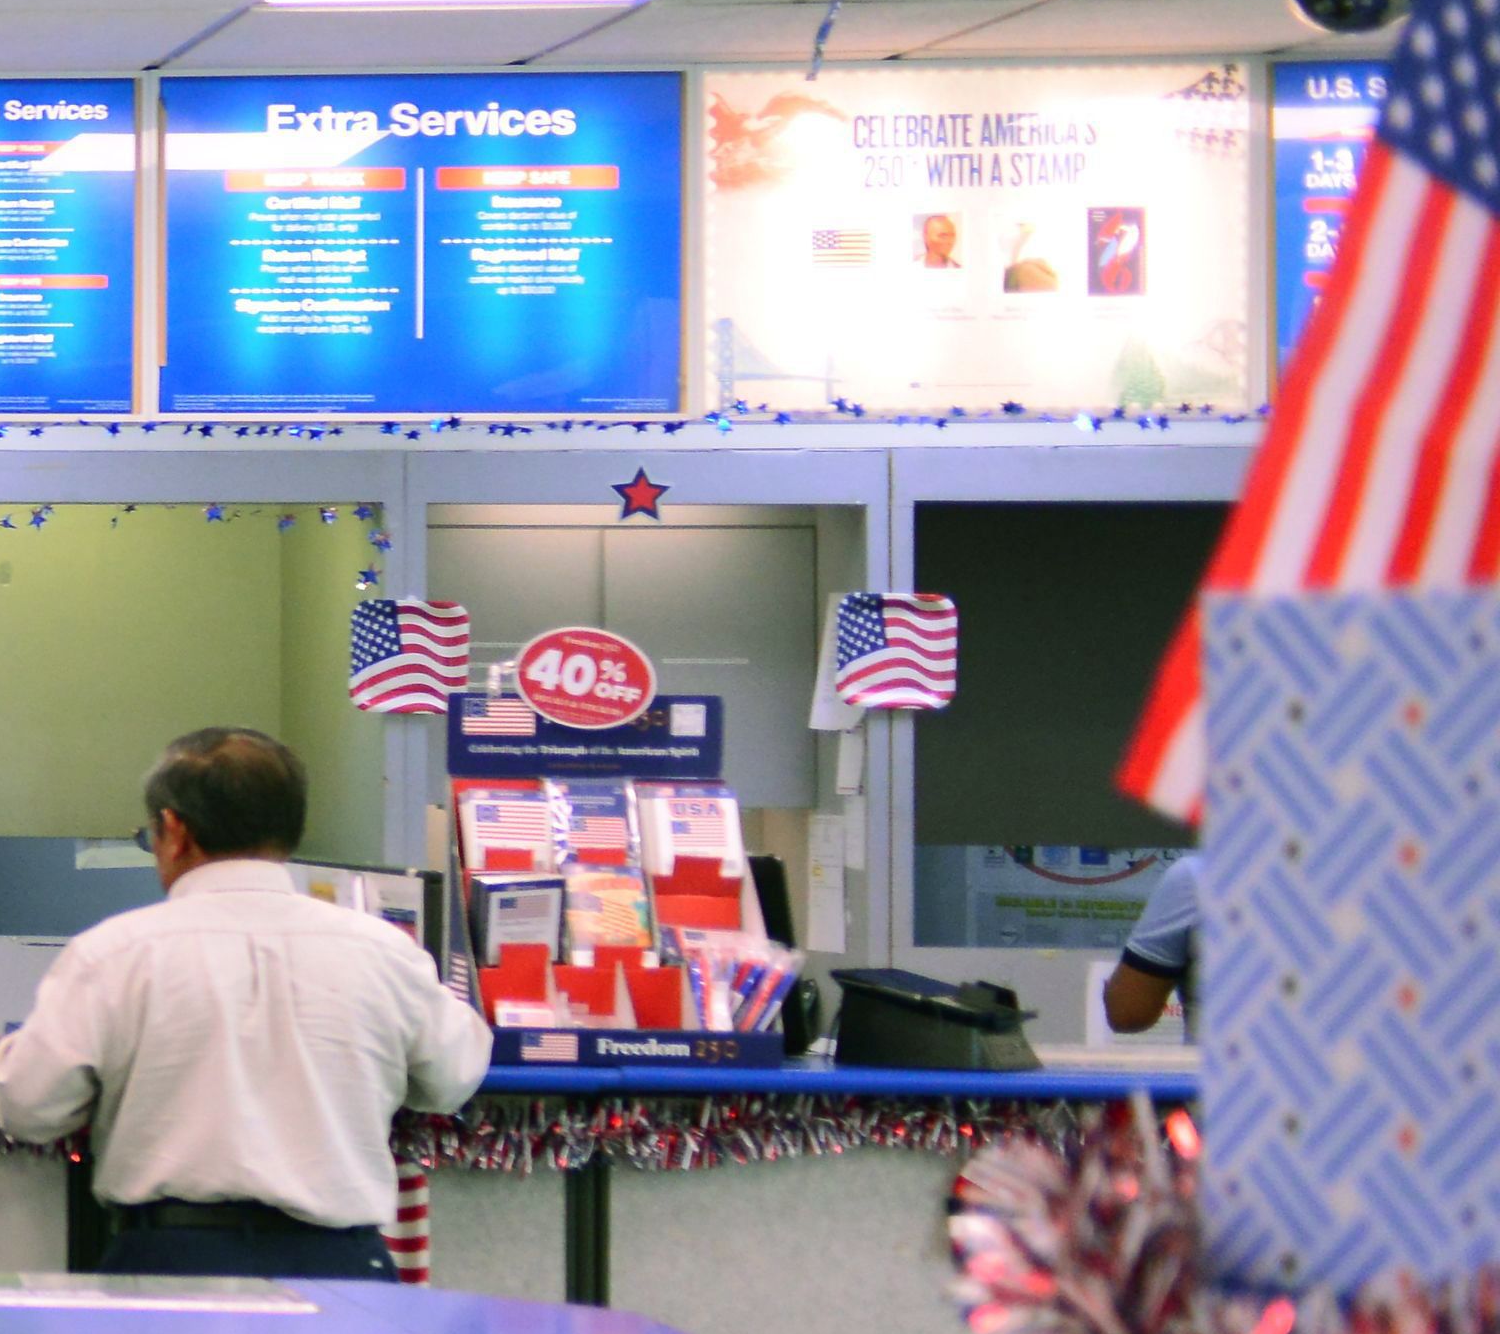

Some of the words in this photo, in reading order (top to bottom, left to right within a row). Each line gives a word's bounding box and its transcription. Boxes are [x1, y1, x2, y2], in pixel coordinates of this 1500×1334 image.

[4, 100, 108, 121] Services
[266, 103, 379, 134] Extra
[389, 102, 577, 137] Services
[854, 113, 973, 149] CELEBRATE
[980, 113, 1097, 147] AMERICAS
[926, 153, 983, 187] WITH
[990, 153, 1004, 187] A
[1010, 153, 1085, 186] STAMP
[594, 682, 642, 703] OFF
[674, 803, 719, 816] USA
[596, 1038, 690, 1056] Freedom
[695, 1039, 739, 1062] 250
